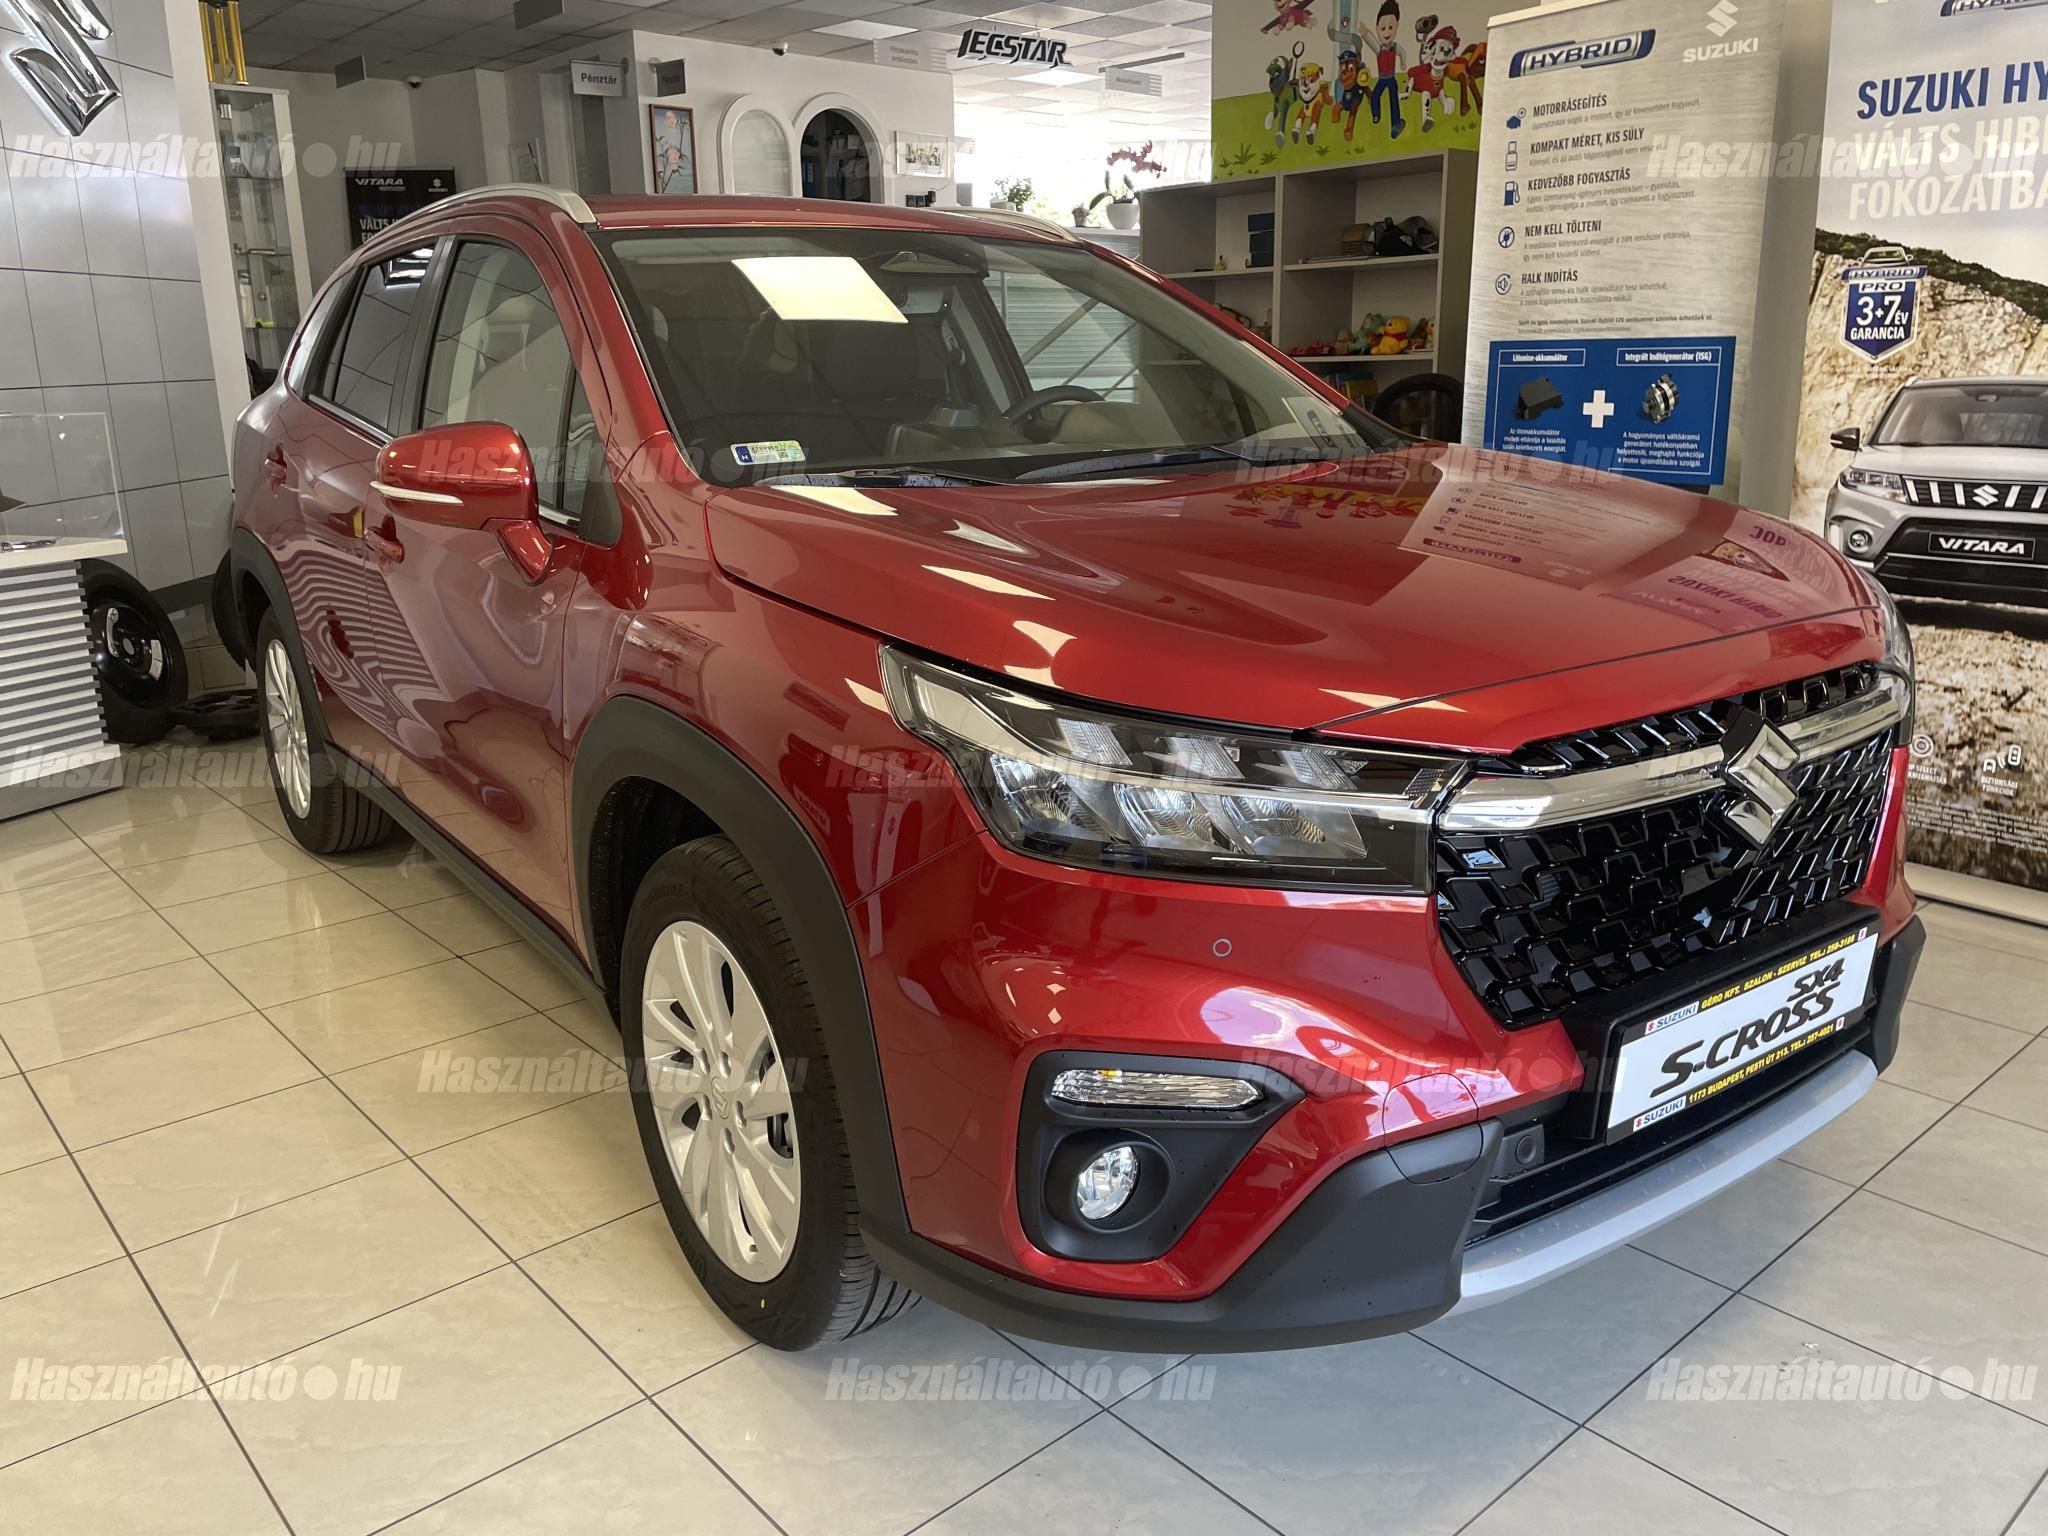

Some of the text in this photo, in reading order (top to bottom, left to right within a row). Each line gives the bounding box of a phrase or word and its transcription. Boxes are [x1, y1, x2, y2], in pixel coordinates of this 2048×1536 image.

[1530, 38, 1632, 70] HYBRID
[1683, 38, 1758, 63] SUZUKI
[581, 72, 617, 85] Pénztár
[1857, 67, 1990, 119] SUZUKI
[1533, 95, 1607, 117] MOTORRÁSEGÍTÉS
[1530, 128, 1645, 154] KOMPAKT MÉRET, KIS SÚLY
[1854, 115, 2048, 170] VÁLTS HIB
[355, 178, 404, 186] VITARA
[1528, 168, 1631, 190] KEDVEZŐBB FOGYASZTÁS
[1525, 219, 1601, 237] NEM KELL TÖLTENI
[1521, 270, 1578, 284] HALK INDÍTÁS
[1853, 268, 1915, 278] HYBRID
[1861, 282, 1903, 291] PRO
[1850, 327, 1905, 340] GARANCIA
[1939, 537, 2024, 555] VITARA
[1786, 958, 1845, 1002] SX4
[1656, 1004, 1697, 1028] SUZUKI
[1743, 971, 1772, 991] SZALON
[1777, 955, 1807, 976] SZERVIZ
[1643, 1099, 1683, 1124] SUZUKI
[1688, 1089, 1707, 1104] 1173
[1707, 1069, 1745, 1096] BUDAPEST,
[1745, 1058, 1765, 1076] PESTI
[1765, 1053, 1775, 1065] ÚT
